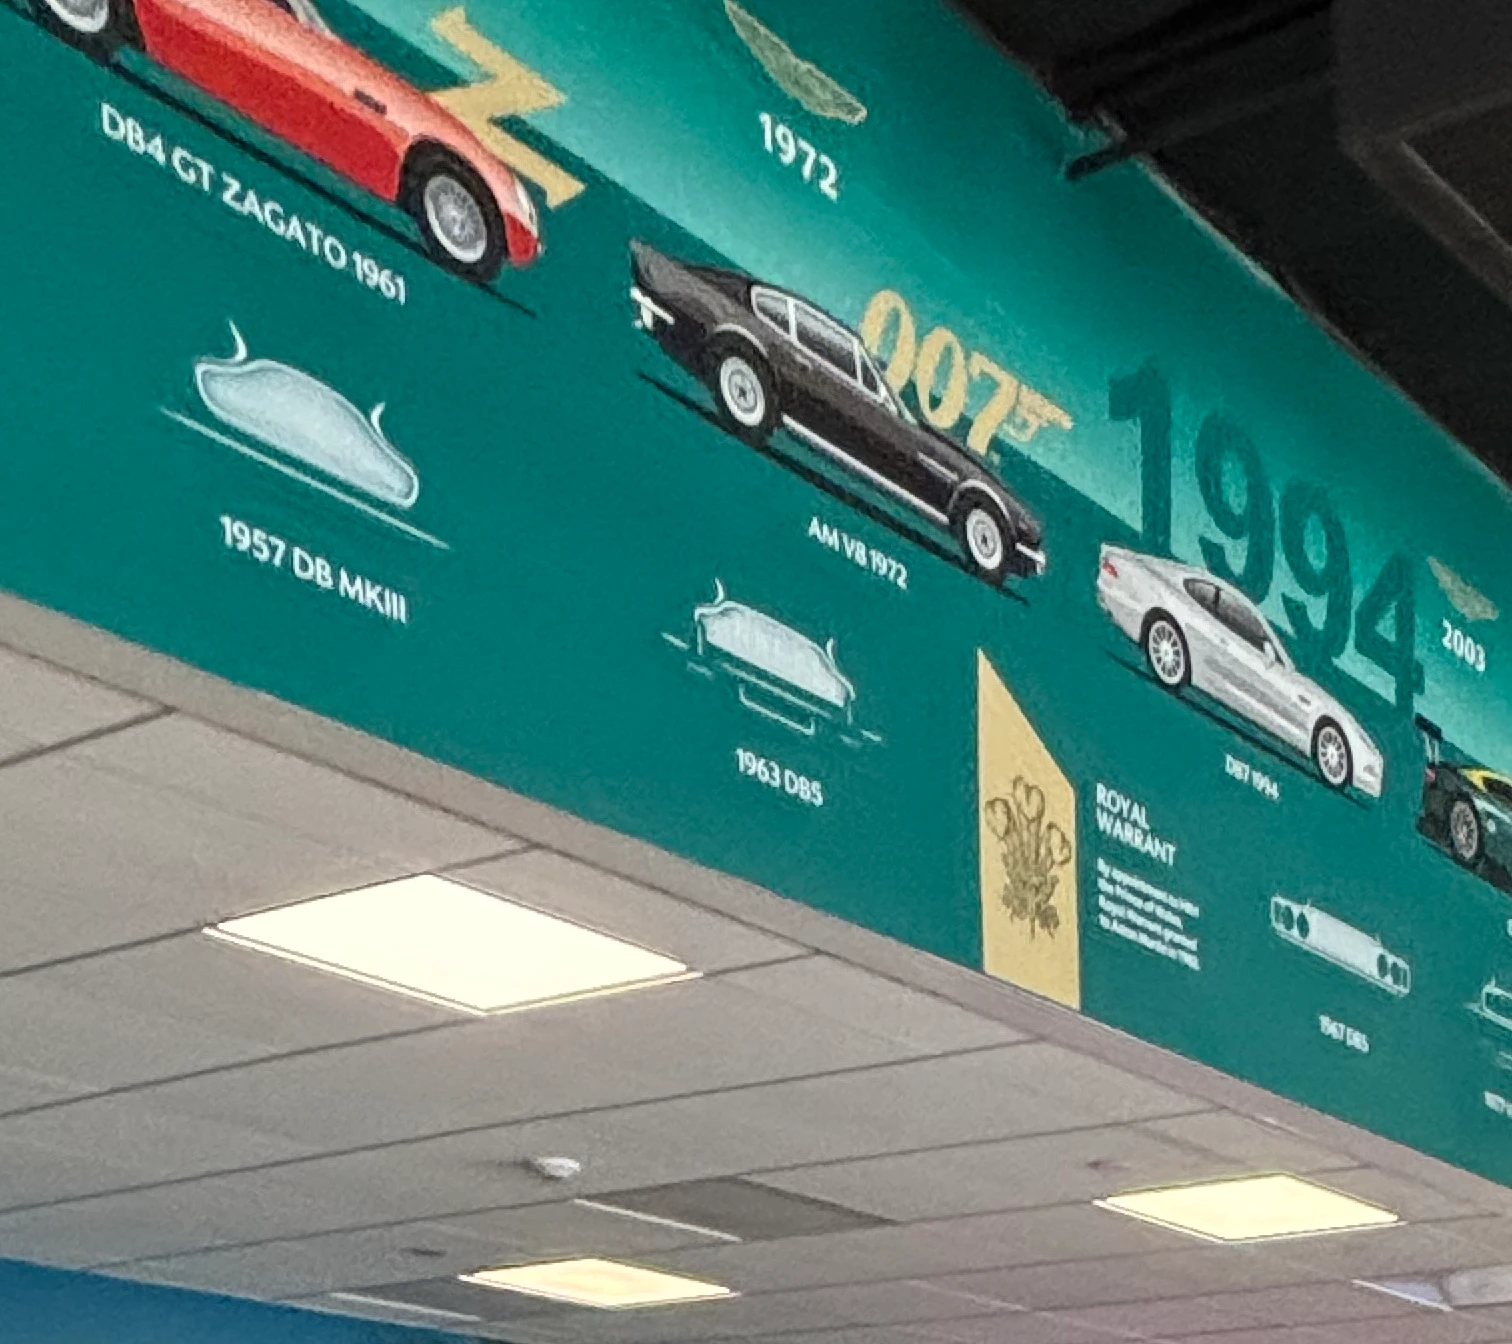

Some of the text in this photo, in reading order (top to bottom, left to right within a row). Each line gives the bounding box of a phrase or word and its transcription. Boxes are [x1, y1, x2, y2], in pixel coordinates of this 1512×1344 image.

[759, 112, 839, 202] 1972
[100, 101, 407, 306] DB4 GT ZAGATO 1961
[860, 288, 1020, 456] 007
[219, 514, 407, 625] 1957 DB MKIII
[808, 516, 908, 590] AM V8 1972
[1108, 363, 1425, 722] 1994
[1442, 618, 1487, 672] 2003
[735, 748, 780, 789] 1963
[1096, 782, 1150, 830] ROYAL
[1096, 806, 1176, 867] WARRANT
